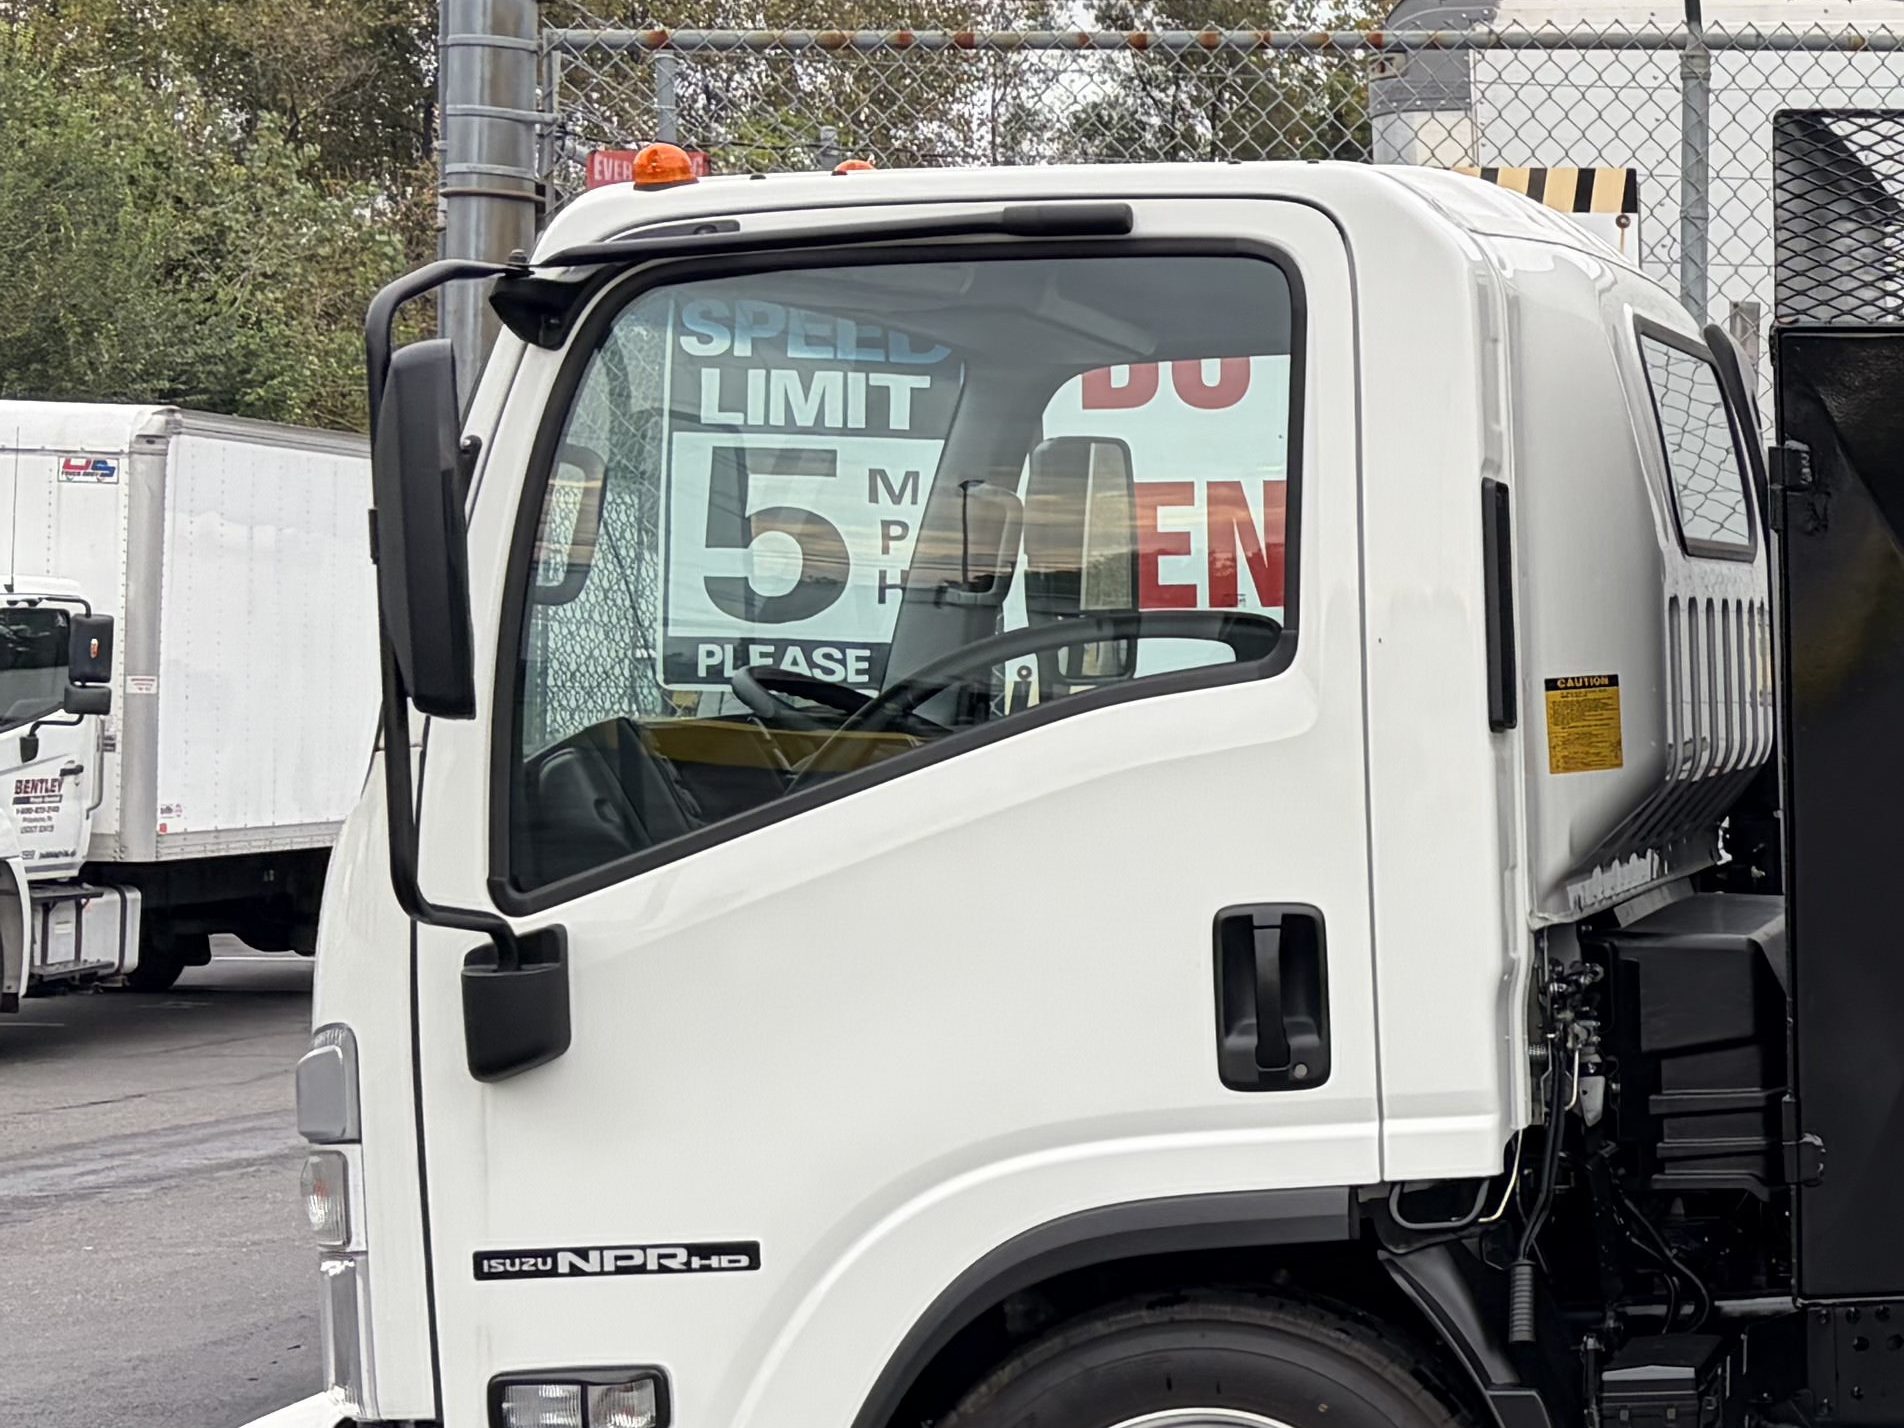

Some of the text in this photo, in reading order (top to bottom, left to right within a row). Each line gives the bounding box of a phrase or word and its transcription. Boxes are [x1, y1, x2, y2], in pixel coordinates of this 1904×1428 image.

[700, 367, 931, 430] LIMIT
[703, 445, 851, 625] 5
[697, 643, 872, 683] PLEASE
[1556, 676, 1609, 688] CAUTION
[14, 777, 65, 795] BENTLEY
[482, 1247, 751, 1273] ISUZU NPR HD
